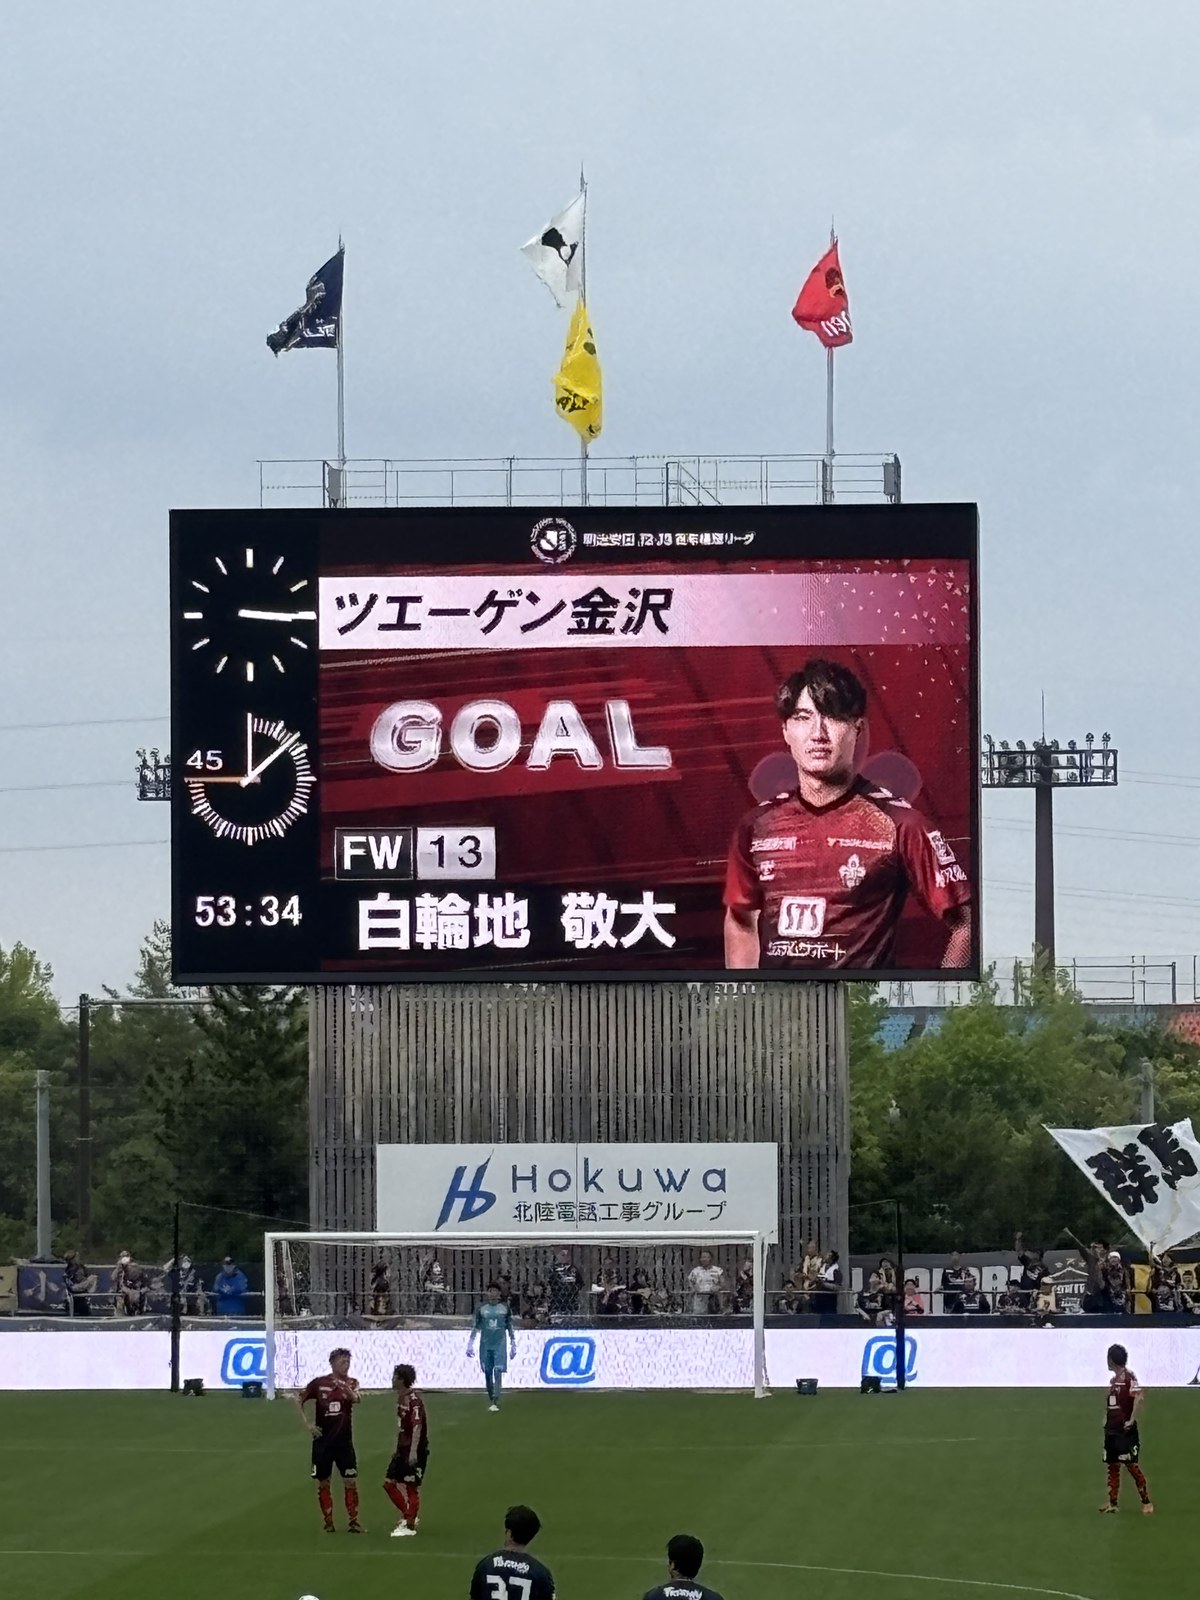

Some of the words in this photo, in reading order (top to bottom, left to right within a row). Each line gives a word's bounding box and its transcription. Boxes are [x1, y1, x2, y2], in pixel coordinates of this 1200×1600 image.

[335, 586, 675, 636] ツエーゲン金沢
[370, 699, 674, 772] GOAL
[186, 749, 223, 770] 45
[342, 835, 403, 870] FW
[429, 835, 484, 869] 13
[194, 895, 303, 928] 53:34
[358, 892, 532, 951] 白輪地
[561, 891, 677, 949] 敬大
[511, 1157, 727, 1193] Hokuwa
[512, 1201, 727, 1222] 北陸電話工事グループ
